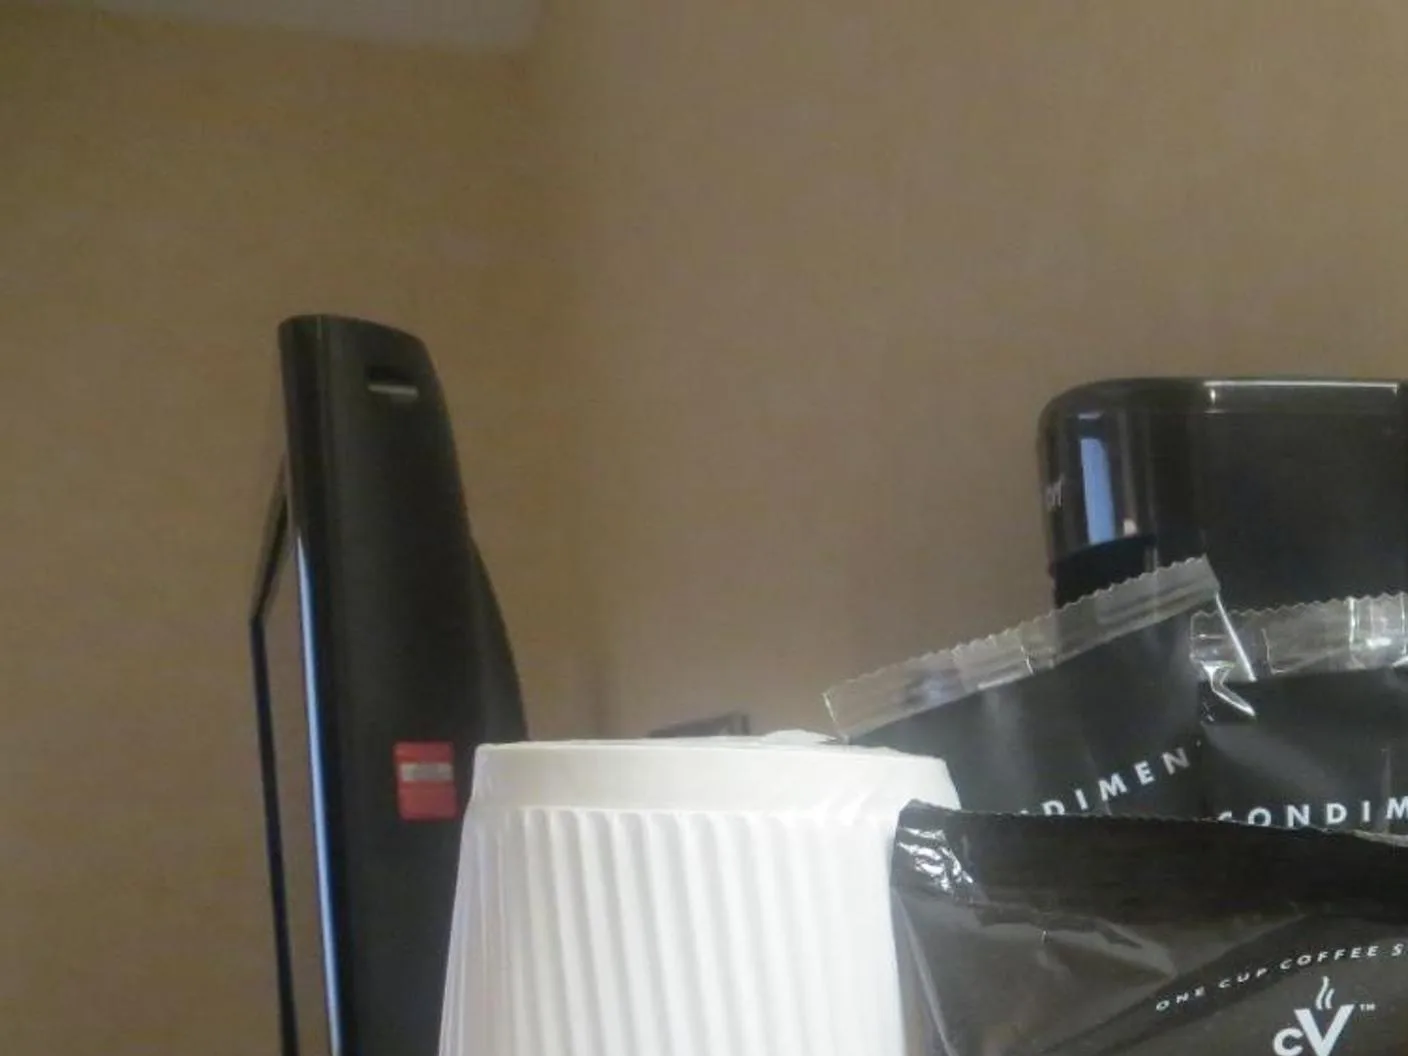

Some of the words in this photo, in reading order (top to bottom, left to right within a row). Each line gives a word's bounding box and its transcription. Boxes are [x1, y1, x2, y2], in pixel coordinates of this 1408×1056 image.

[1155, 986, 1205, 1012] ONE
[1218, 967, 1268, 989] CUP
[1279, 944, 1379, 971] COFFEE
